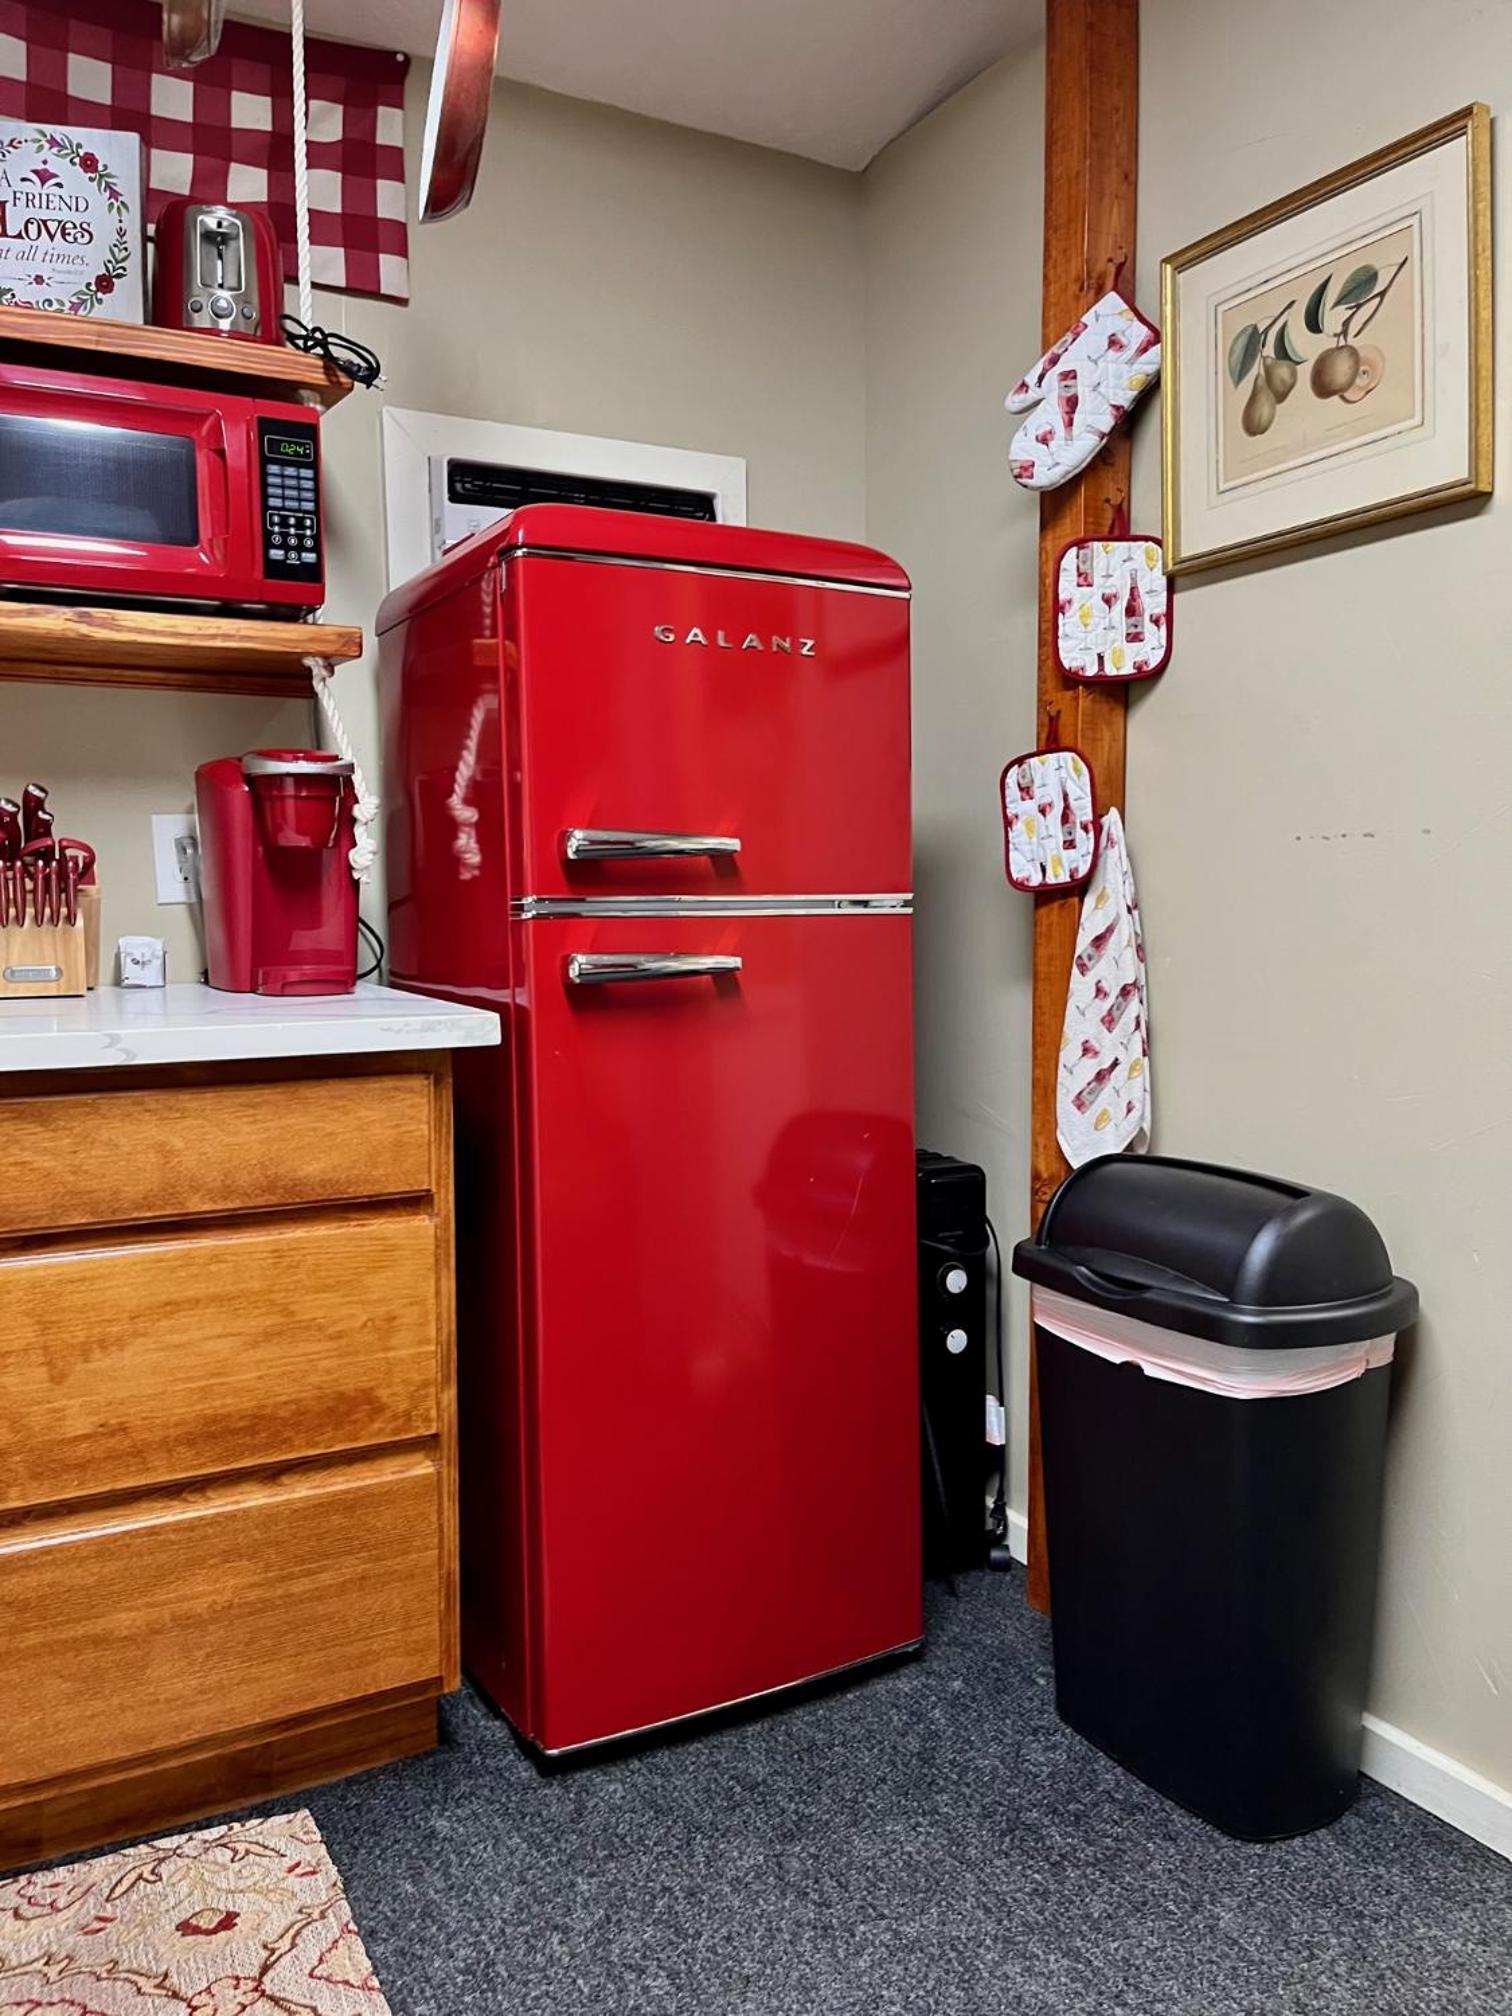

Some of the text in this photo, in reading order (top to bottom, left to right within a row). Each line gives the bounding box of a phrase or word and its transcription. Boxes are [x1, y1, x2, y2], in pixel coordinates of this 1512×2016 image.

[12, 190, 89, 213] FRIEND
[15, 245, 38, 261] all
[41, 247, 89, 266] times.
[654, 624, 816, 656] GALANZ
